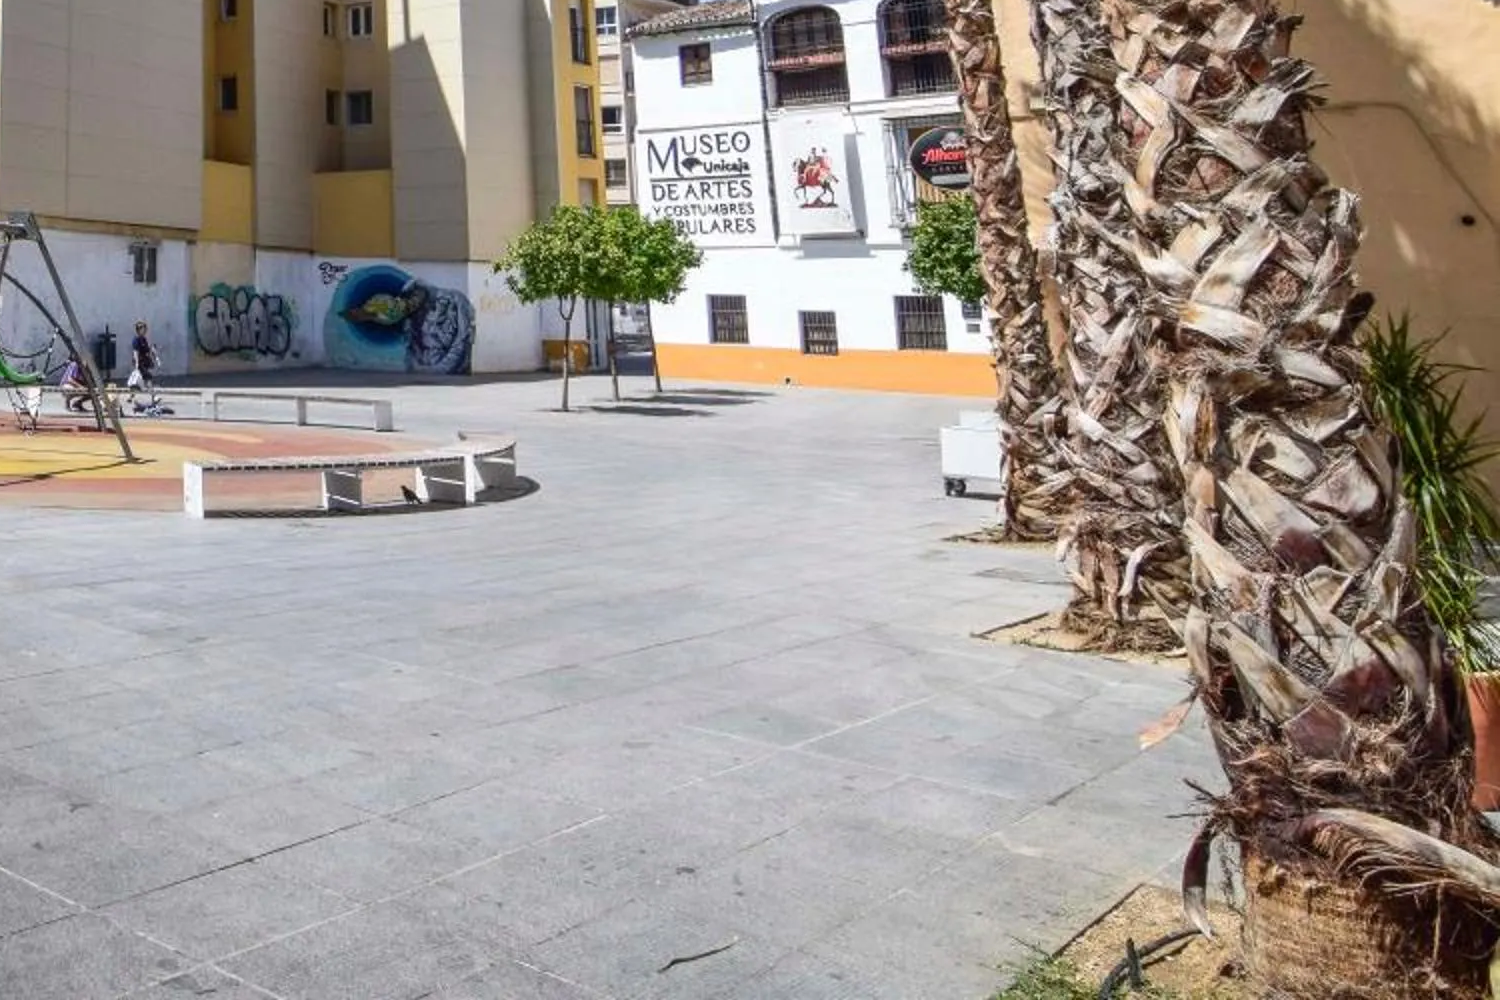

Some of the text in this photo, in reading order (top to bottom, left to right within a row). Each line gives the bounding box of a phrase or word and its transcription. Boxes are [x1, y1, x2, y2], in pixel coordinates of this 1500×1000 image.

[647, 131, 751, 178] MUSEO
[922, 147, 965, 164] Alham
[703, 158, 750, 174] Unicaja
[651, 180, 753, 202] DE ARTES
[653, 202, 755, 217] Y COSTUMBRES
[657, 218, 757, 236] PULARES
